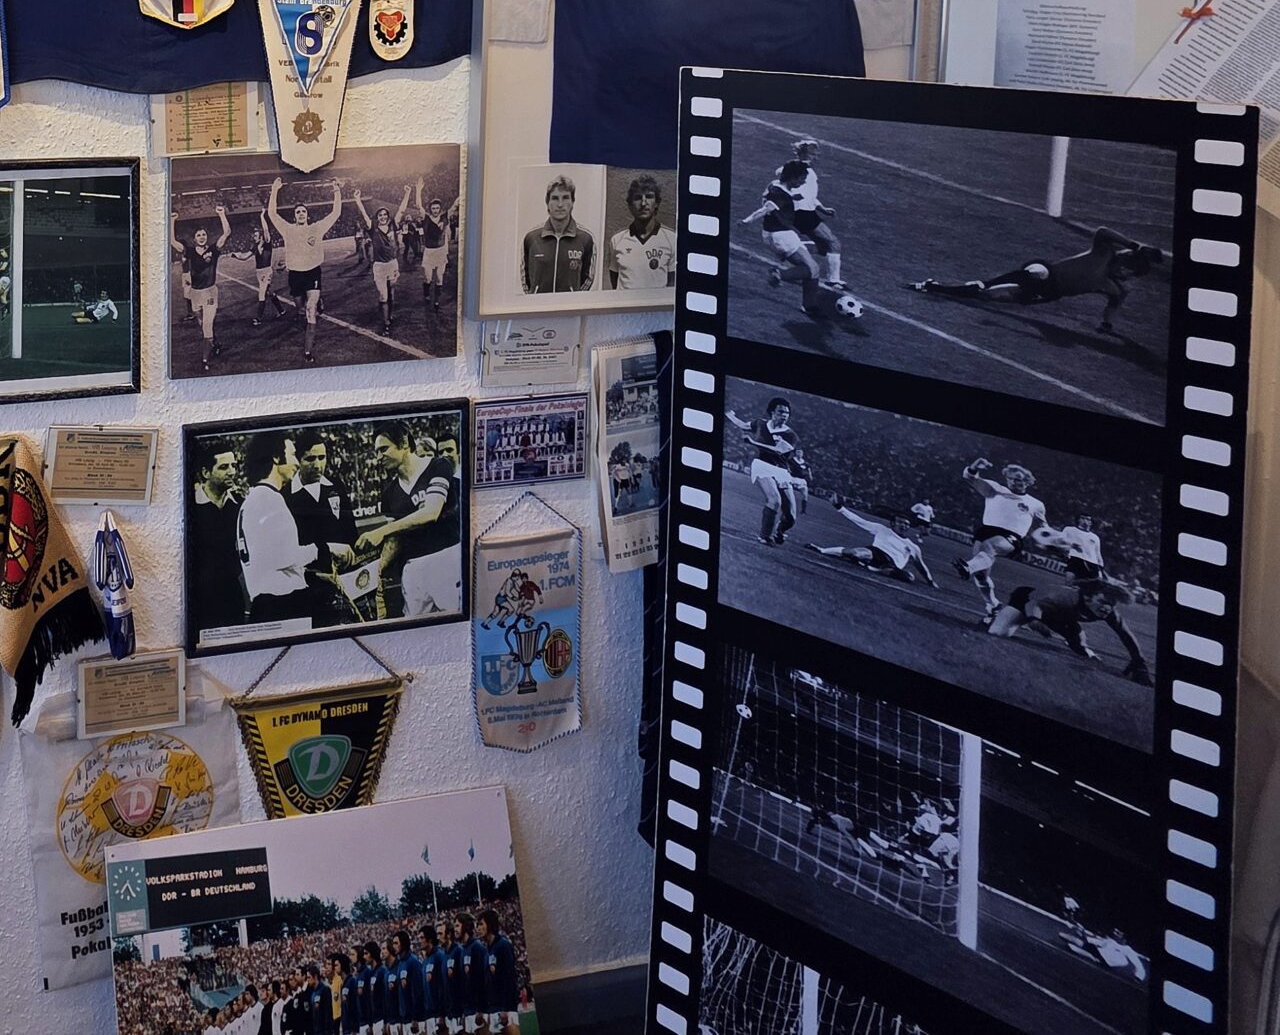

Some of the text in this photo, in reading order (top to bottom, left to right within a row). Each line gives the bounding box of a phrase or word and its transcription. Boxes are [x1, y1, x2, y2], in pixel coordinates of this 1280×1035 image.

[487, 551, 569, 572] Europacupsieger
[547, 560, 570, 574] 1974
[32, 557, 79, 613] NVA
[279, 702, 369, 725] FC DYNAMO DRESDEN
[285, 775, 353, 814] DRESDEN
[113, 808, 165, 838] DRESDEN
[145, 863, 268, 886] VOLKSPARKSTADION HAMBURG
[161, 891, 177, 902] DDR
[204, 882, 256, 896] DEUTSCHLAND
[73, 922, 104, 938] 1953
